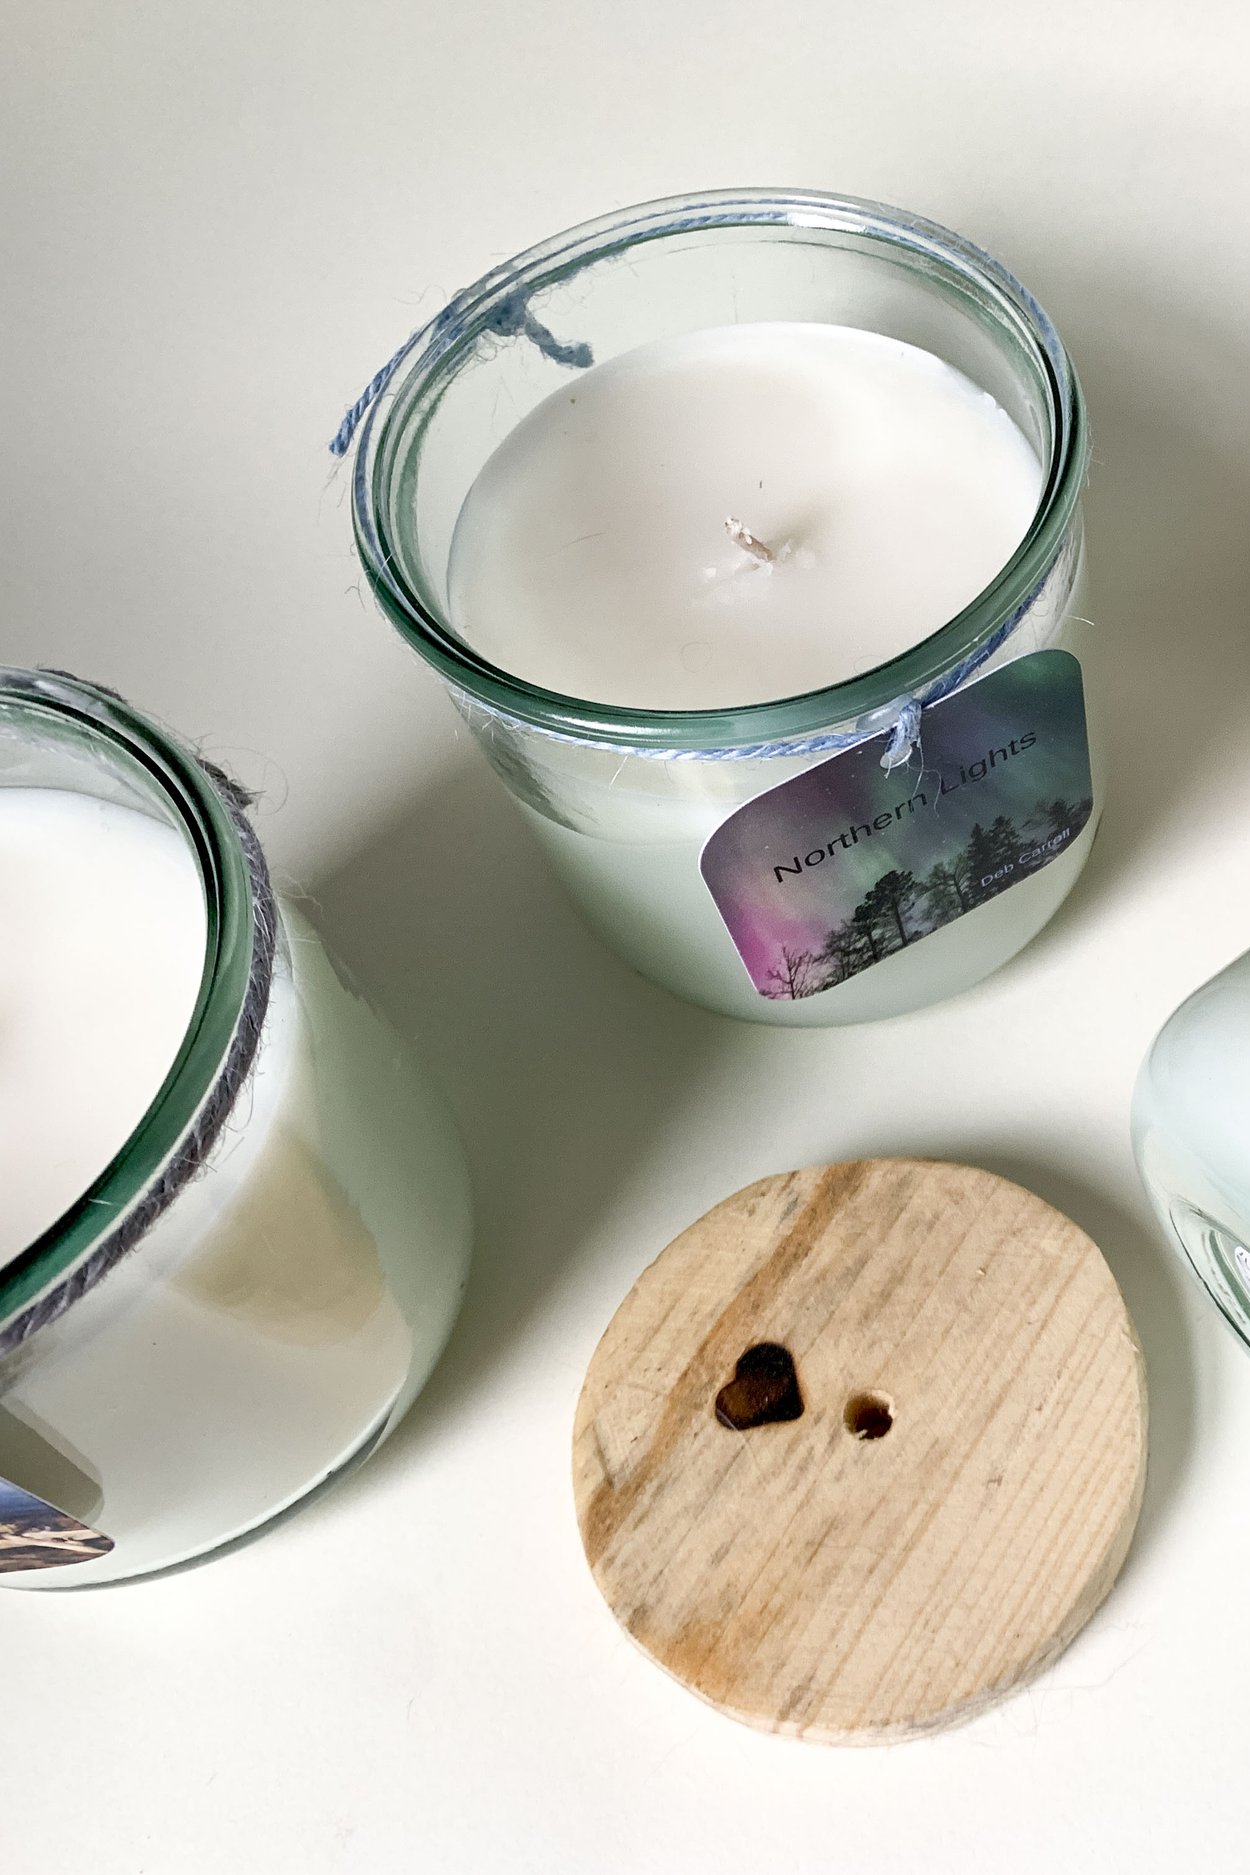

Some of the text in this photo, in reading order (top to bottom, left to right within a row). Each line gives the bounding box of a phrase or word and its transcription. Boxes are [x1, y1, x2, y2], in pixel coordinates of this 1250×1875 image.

[773, 731, 1038, 883] Northern Lights
[981, 863, 1015, 888] Deb
